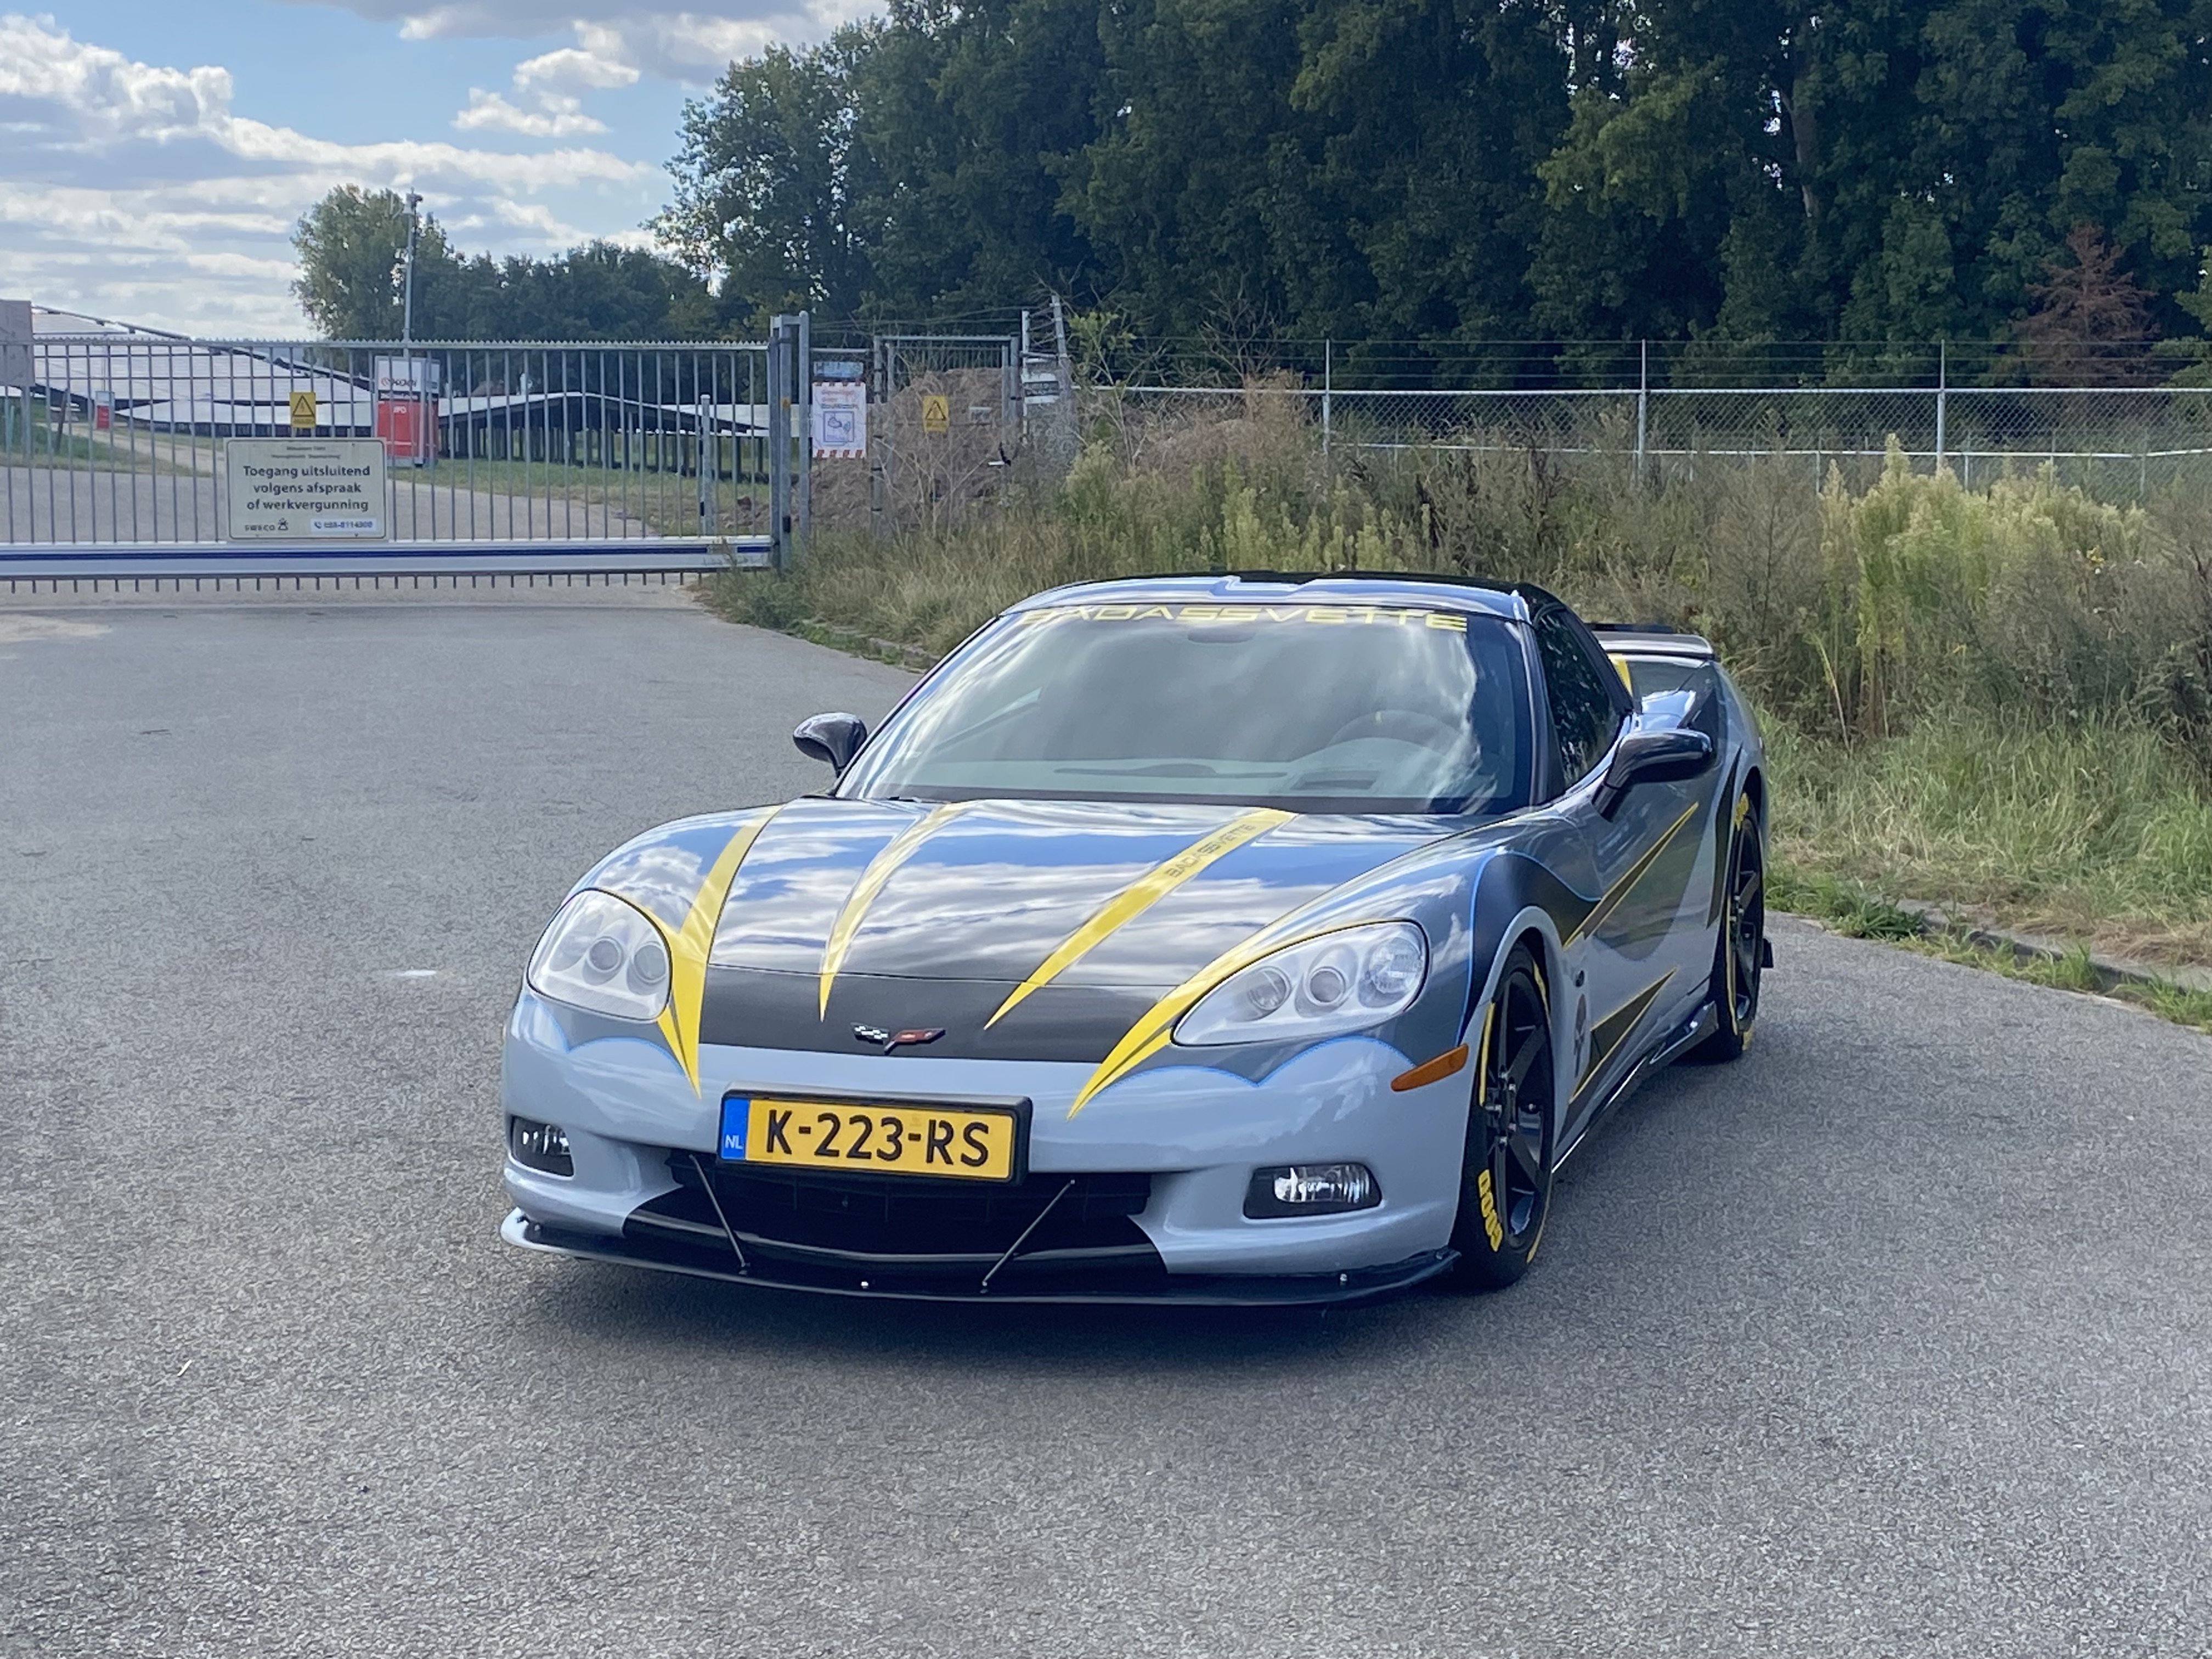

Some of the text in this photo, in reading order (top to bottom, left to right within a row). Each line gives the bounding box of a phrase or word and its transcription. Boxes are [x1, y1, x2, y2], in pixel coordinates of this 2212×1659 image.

[243, 465, 370, 479] Toegang uitsluitend
[253, 482, 362, 495] volgens afspraak
[247, 499, 369, 512] of werkvergunning
[1164, 824, 1256, 878] BADASSVETTE
[724, 1135, 744, 1150] NL
[766, 1109, 989, 1167] K-223-RS
